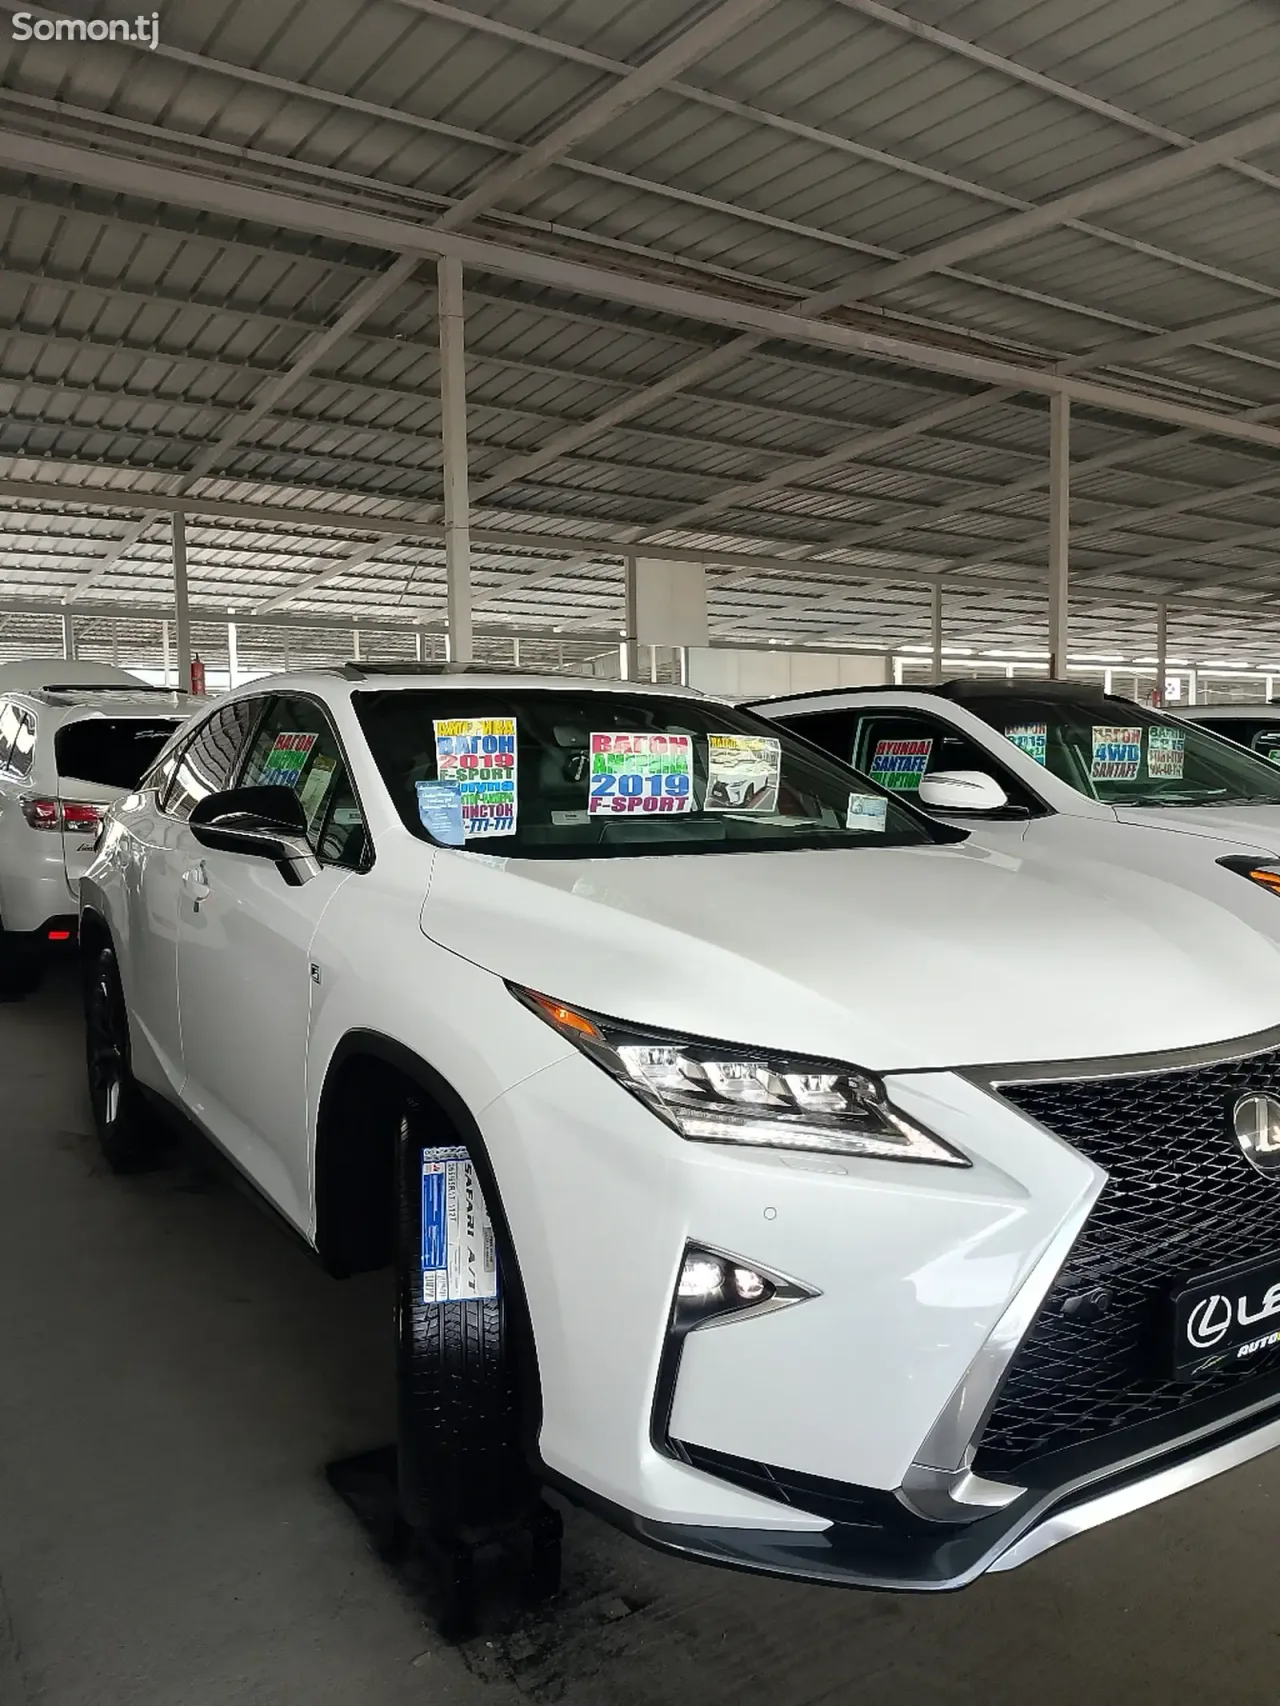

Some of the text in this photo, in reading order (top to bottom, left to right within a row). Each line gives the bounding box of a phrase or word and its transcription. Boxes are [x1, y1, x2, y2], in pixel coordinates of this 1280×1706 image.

[437, 735, 514, 755] ВАГОН
[592, 734, 688, 754] ВАГОН
[876, 741, 931, 755] HYUNDAI
[1095, 744, 1140, 761] 4WD
[439, 754, 514, 769] 2019
[871, 755, 928, 771] SANTAFE
[1092, 762, 1138, 777] SANTAFE
[440, 768, 514, 781] F-SPORT
[591, 774, 690, 796] 2019
[589, 796, 689, 813] F-SPORT
[464, 1163, 476, 1294] SAFARI A/T
[1237, 1331, 1280, 1358] AUTO
